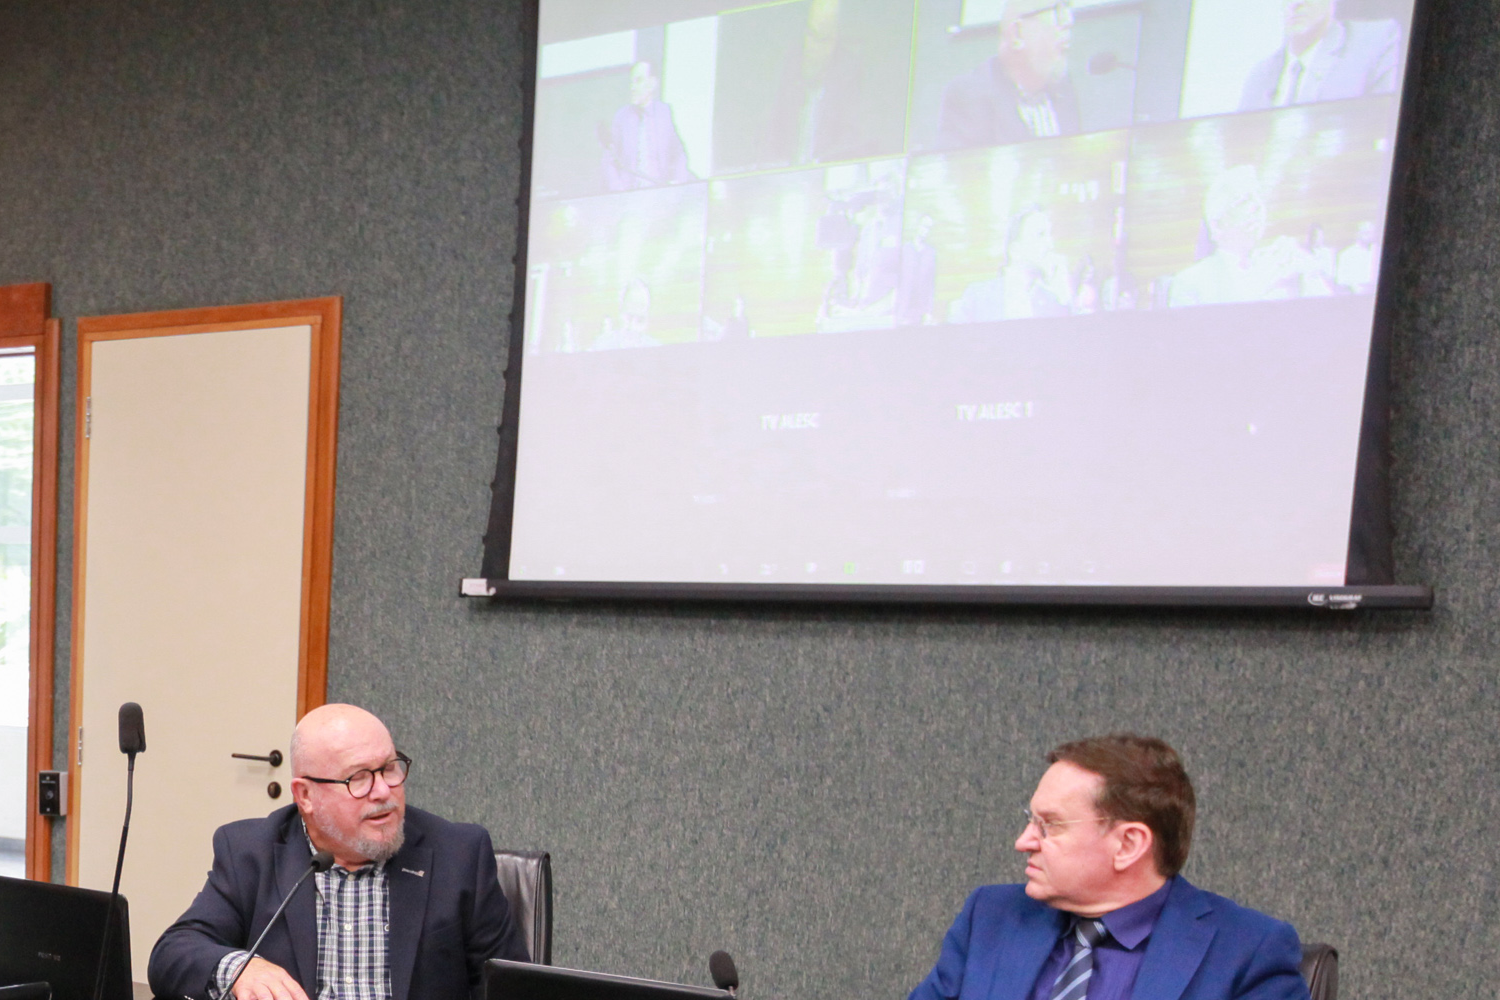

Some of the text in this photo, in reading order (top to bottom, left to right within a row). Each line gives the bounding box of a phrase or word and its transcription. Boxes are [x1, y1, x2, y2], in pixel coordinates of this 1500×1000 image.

[956, 405, 977, 421] TV
[978, 402, 1021, 419] ALESC
[760, 414, 778, 430] TV
